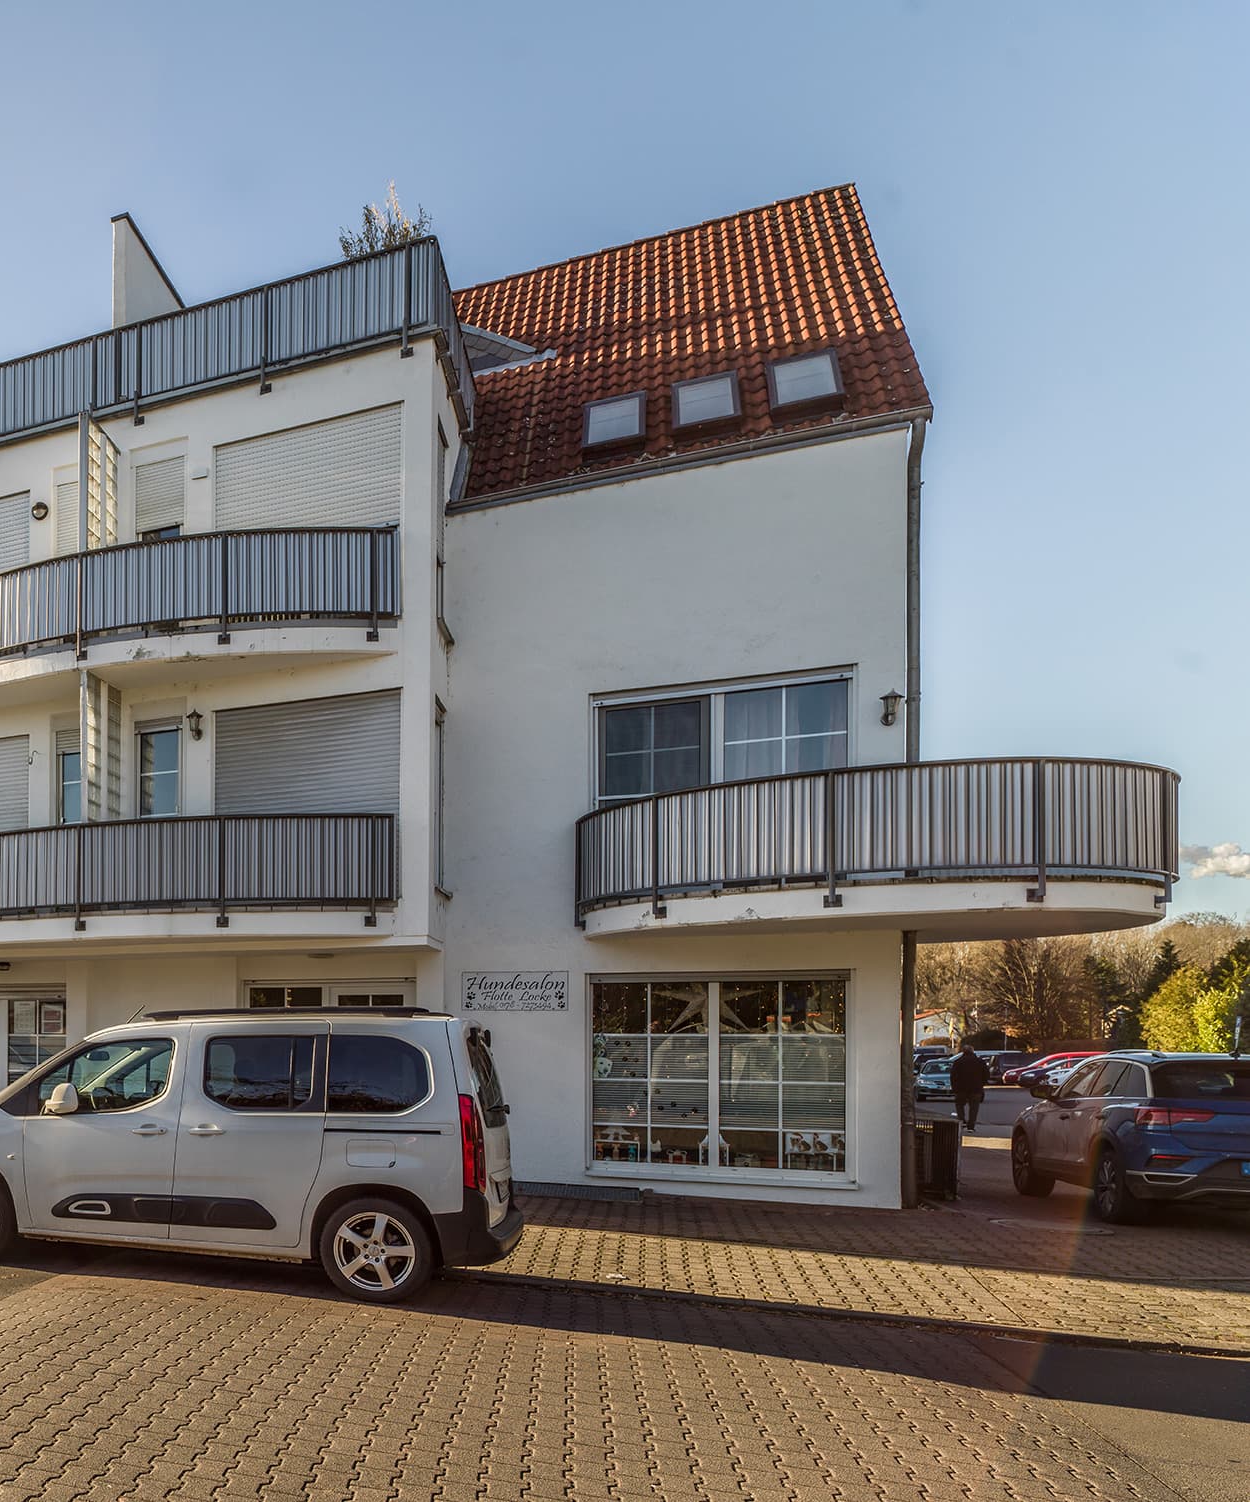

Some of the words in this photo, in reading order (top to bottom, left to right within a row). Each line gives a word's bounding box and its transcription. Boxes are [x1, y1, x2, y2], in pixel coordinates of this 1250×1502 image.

[467, 974, 565, 990] Hundesalon
[481, 990, 513, 1001] Flotte
[519, 990, 551, 1001] Locke
